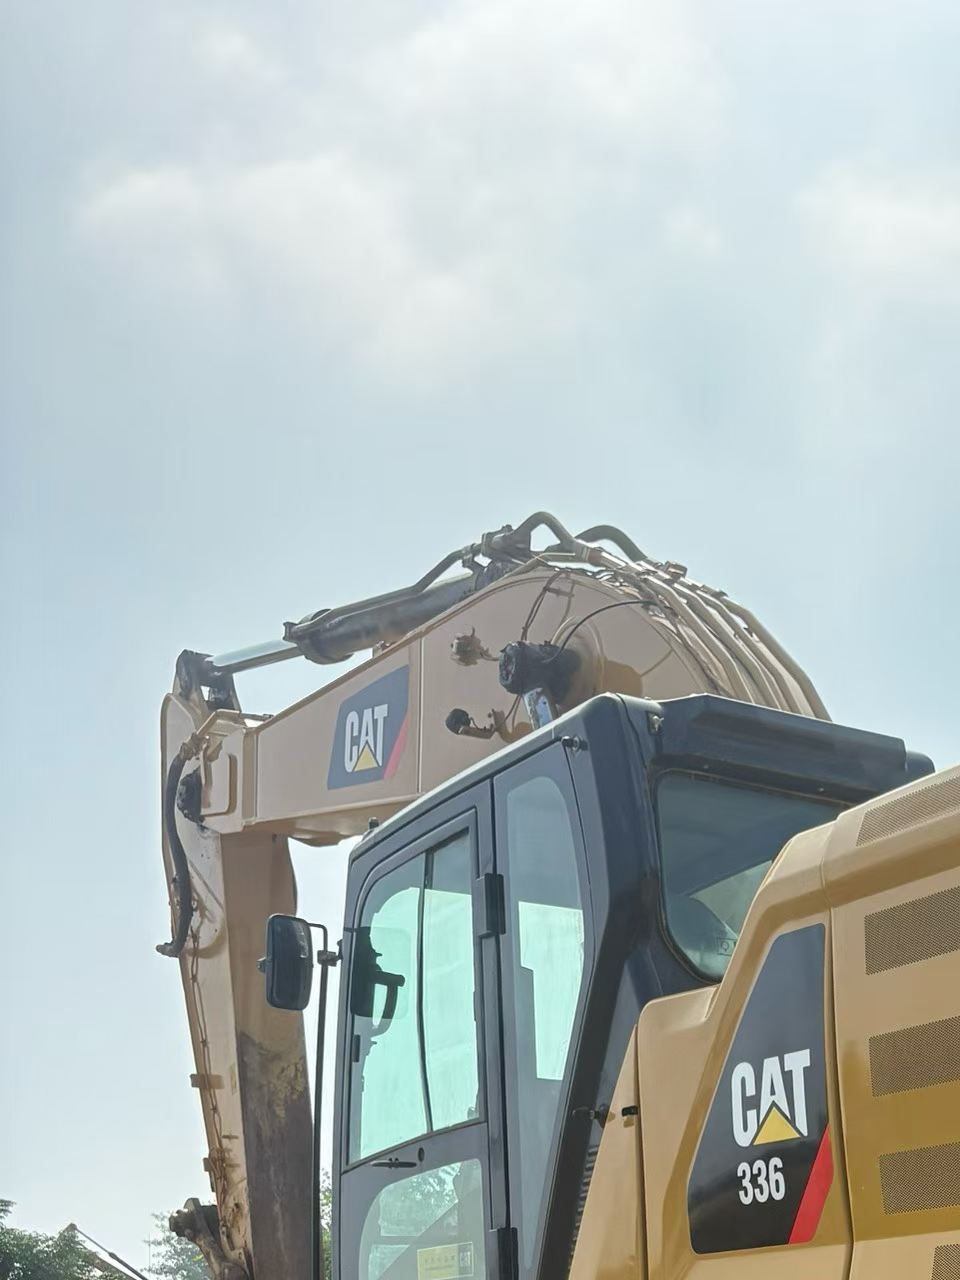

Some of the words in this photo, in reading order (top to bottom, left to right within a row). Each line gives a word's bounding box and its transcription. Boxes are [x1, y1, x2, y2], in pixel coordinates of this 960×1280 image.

[345, 704, 388, 772] CAT
[731, 1049, 811, 1147] CAT
[737, 1157, 785, 1205] 336
